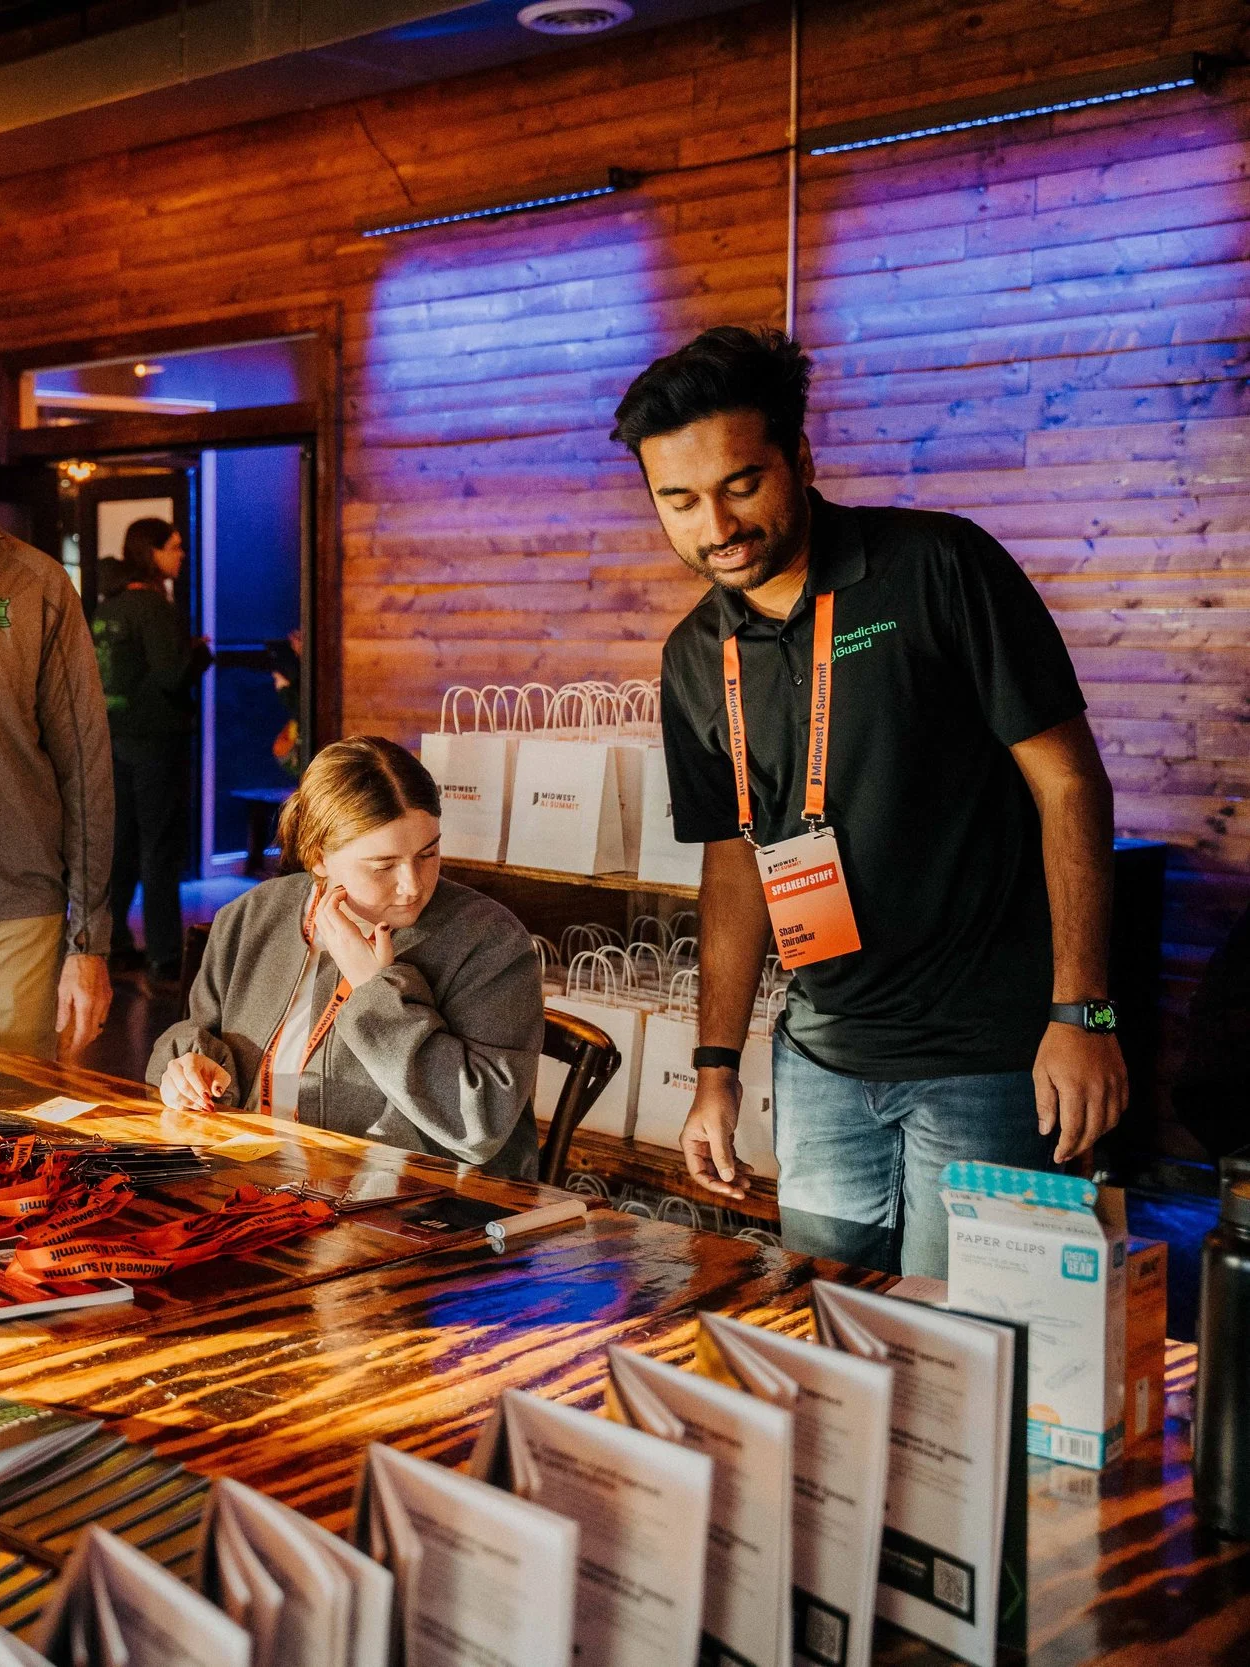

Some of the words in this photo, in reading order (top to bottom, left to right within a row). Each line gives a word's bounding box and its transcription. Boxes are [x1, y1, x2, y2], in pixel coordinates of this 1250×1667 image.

[833, 620, 897, 646] Prediction
[836, 637, 872, 658] Guard
[815, 662, 827, 710] Summit
[728, 687, 742, 736] Midwest
[816, 712, 825, 724] AI
[734, 737, 742, 749] AI
[812, 726, 825, 776] Midwest
[735, 750, 746, 797] Summit
[443, 784, 478, 793] MIDWEST
[453, 793, 482, 801] SUMMIT
[541, 792, 576, 802] MIDWEST
[549, 800, 580, 811] SUMMIT
[773, 856, 798, 868] MIDWEST
[771, 868, 834, 896] SPEAKER/STAFF
[778, 923, 804, 937] Sharan
[781, 931, 816, 948] Shirodkar
[311, 1001, 339, 1044] Midwest
[262, 1052, 272, 1098] Midwest
[672, 1072, 696, 1083] MIDW
[420, 1219, 450, 1230] VIP
[956, 1231, 1001, 1247] PAPER
[1005, 1239, 1046, 1256] CLIPS
[50, 1243, 100, 1262] Summit
[43, 1263, 99, 1279] Summit
[101, 1262, 113, 1273] AI
[115, 1262, 167, 1277] Midwest
